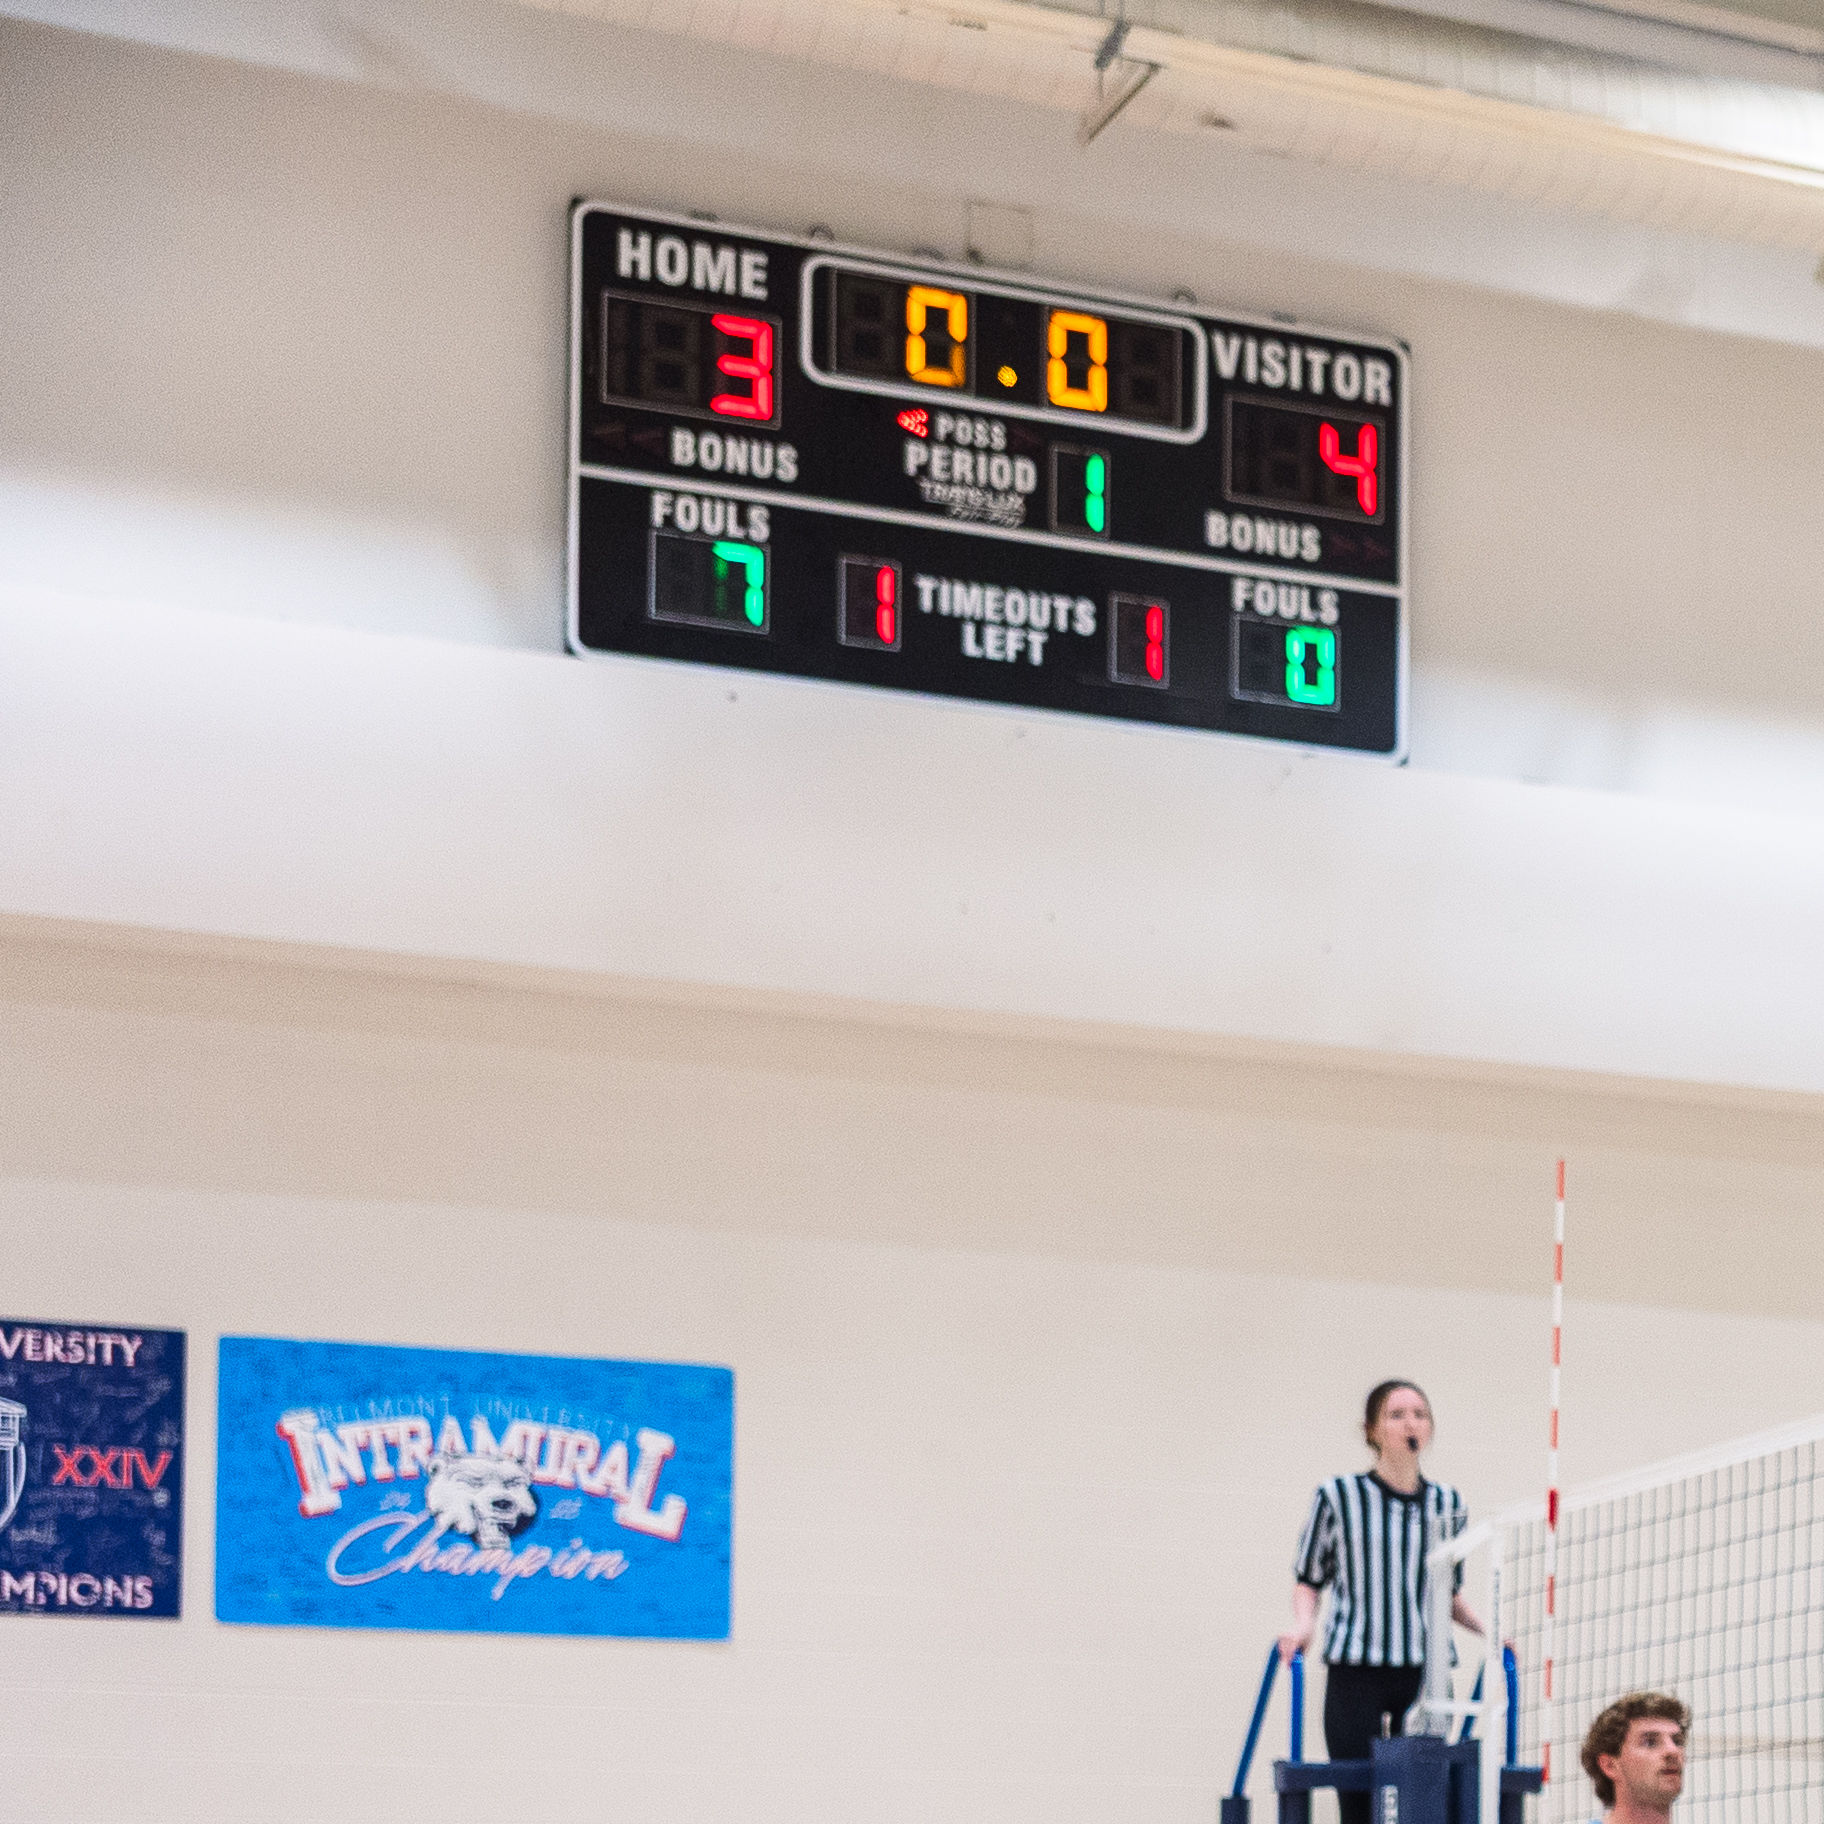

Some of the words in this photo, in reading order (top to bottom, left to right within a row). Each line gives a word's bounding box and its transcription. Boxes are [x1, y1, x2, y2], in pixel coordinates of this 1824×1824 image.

[617, 229, 769, 300] HOME
[710, 313, 773, 420] 3
[1212, 330, 1393, 406] VISITOR
[670, 428, 799, 484] BONUS
[903, 439, 1037, 495] PERIOD
[934, 412, 1007, 451] POSS
[1086, 453, 1105, 532] 1
[1320, 422, 1377, 515] 4
[651, 491, 771, 543] FOULS
[1205, 510, 1322, 563] BONUS
[713, 541, 765, 627] 7
[877, 565, 895, 644] 1
[915, 575, 1097, 636] TIMEOUTS
[1232, 576, 1341, 625] FOULS
[960, 620, 1049, 667] LEFT
[1146, 605, 1164, 681] 1
[1286, 626, 1335, 706] 0
[52, 1443, 173, 1489] XXIV
[276, 1407, 688, 1543] INTRAMURAL
[326, 1511, 629, 1600] Champion
